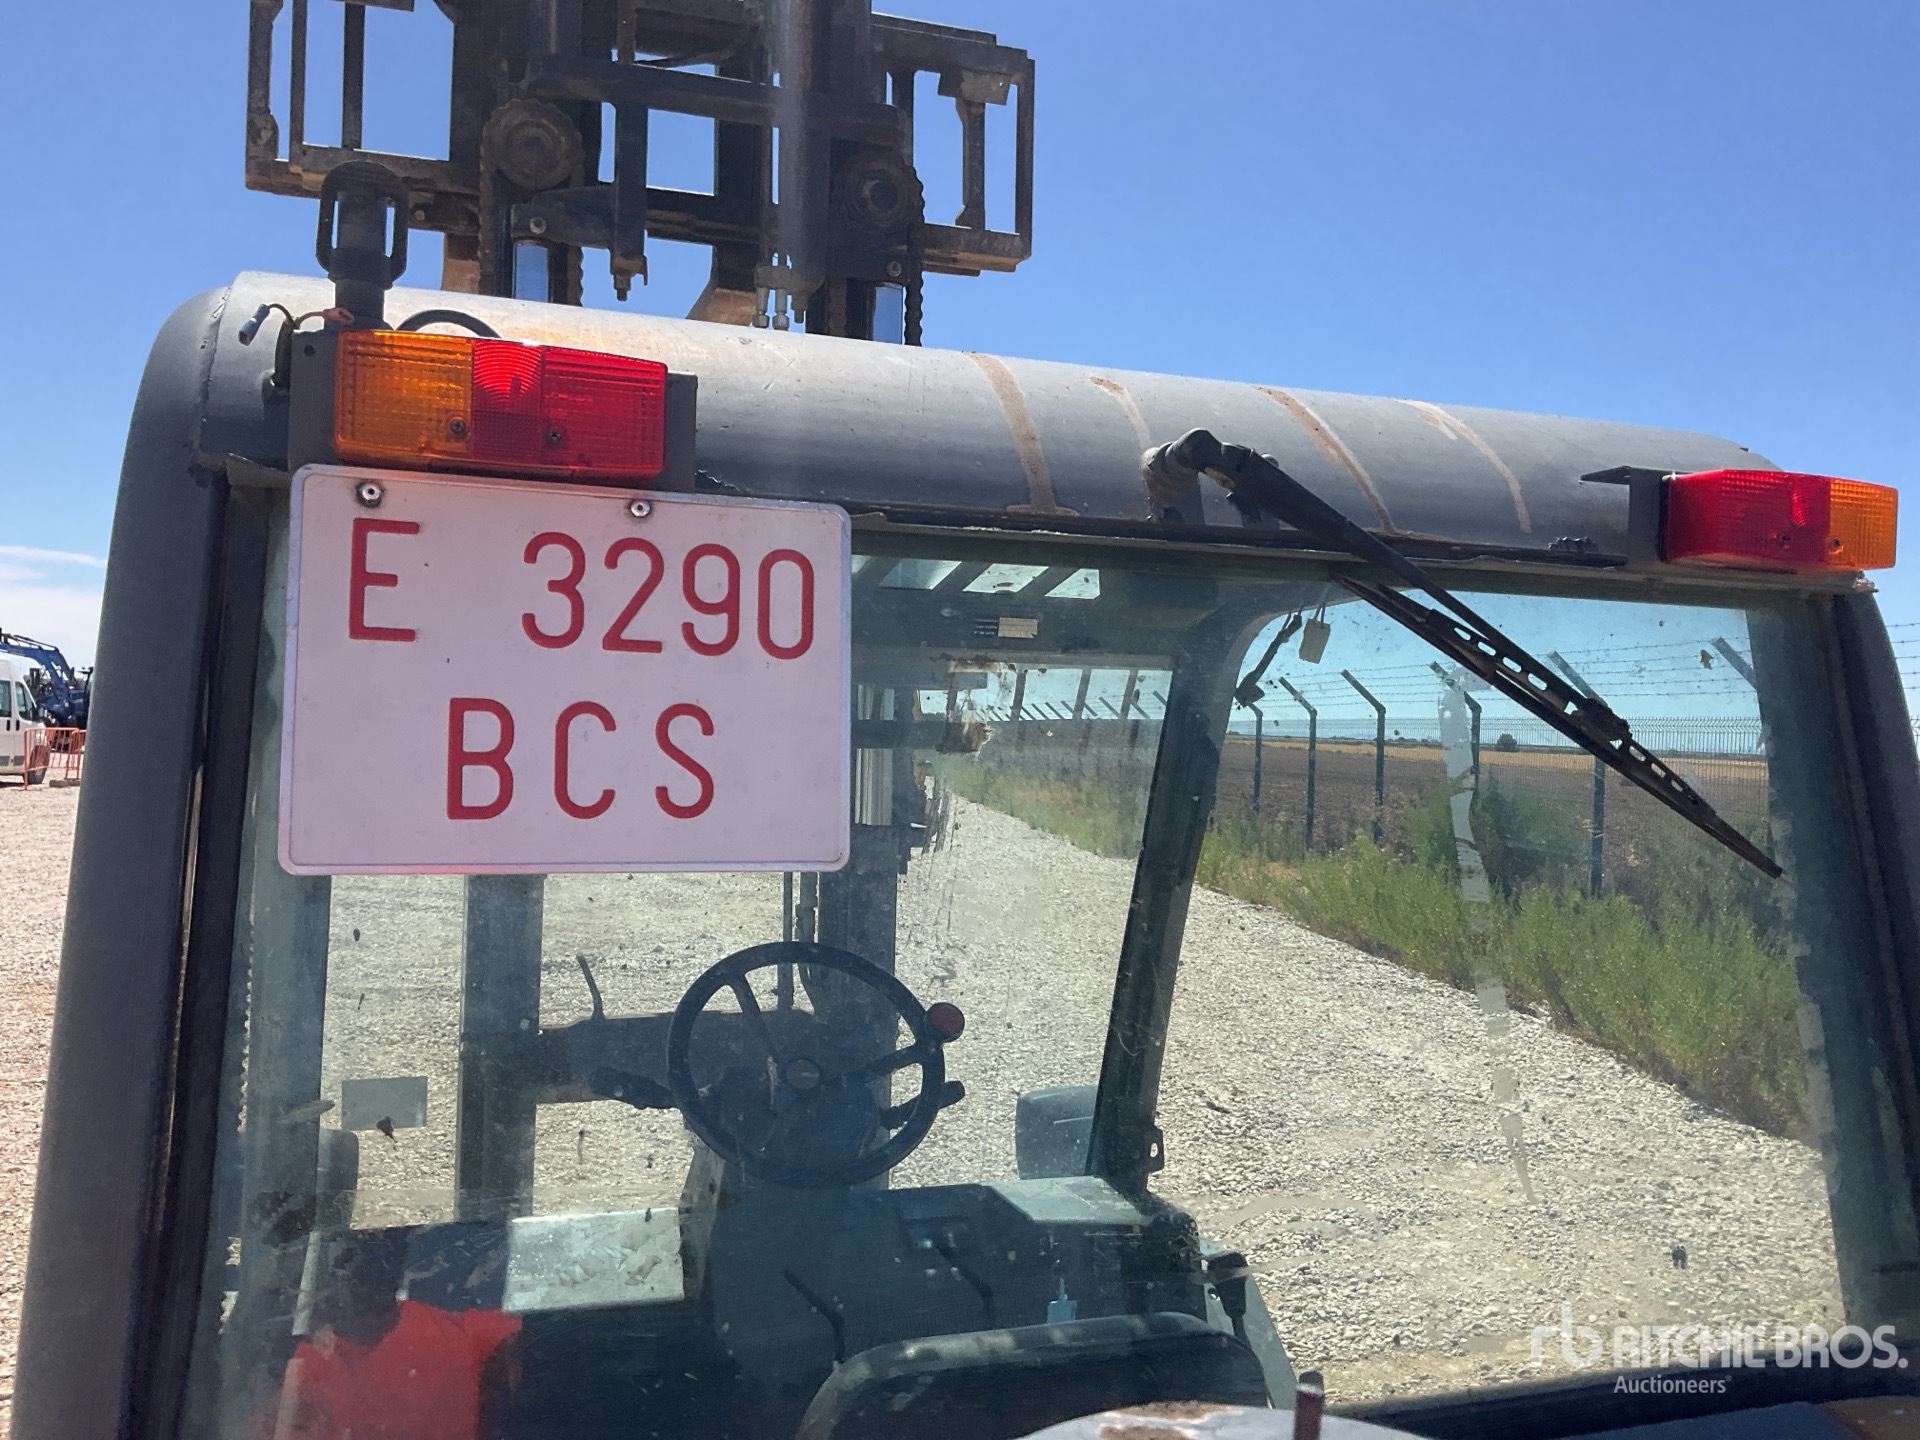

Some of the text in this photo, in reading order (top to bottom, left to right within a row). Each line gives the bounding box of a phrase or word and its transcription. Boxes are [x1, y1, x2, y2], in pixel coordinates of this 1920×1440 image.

[349, 517, 815, 660] E 3290
[446, 697, 716, 820] BCS
